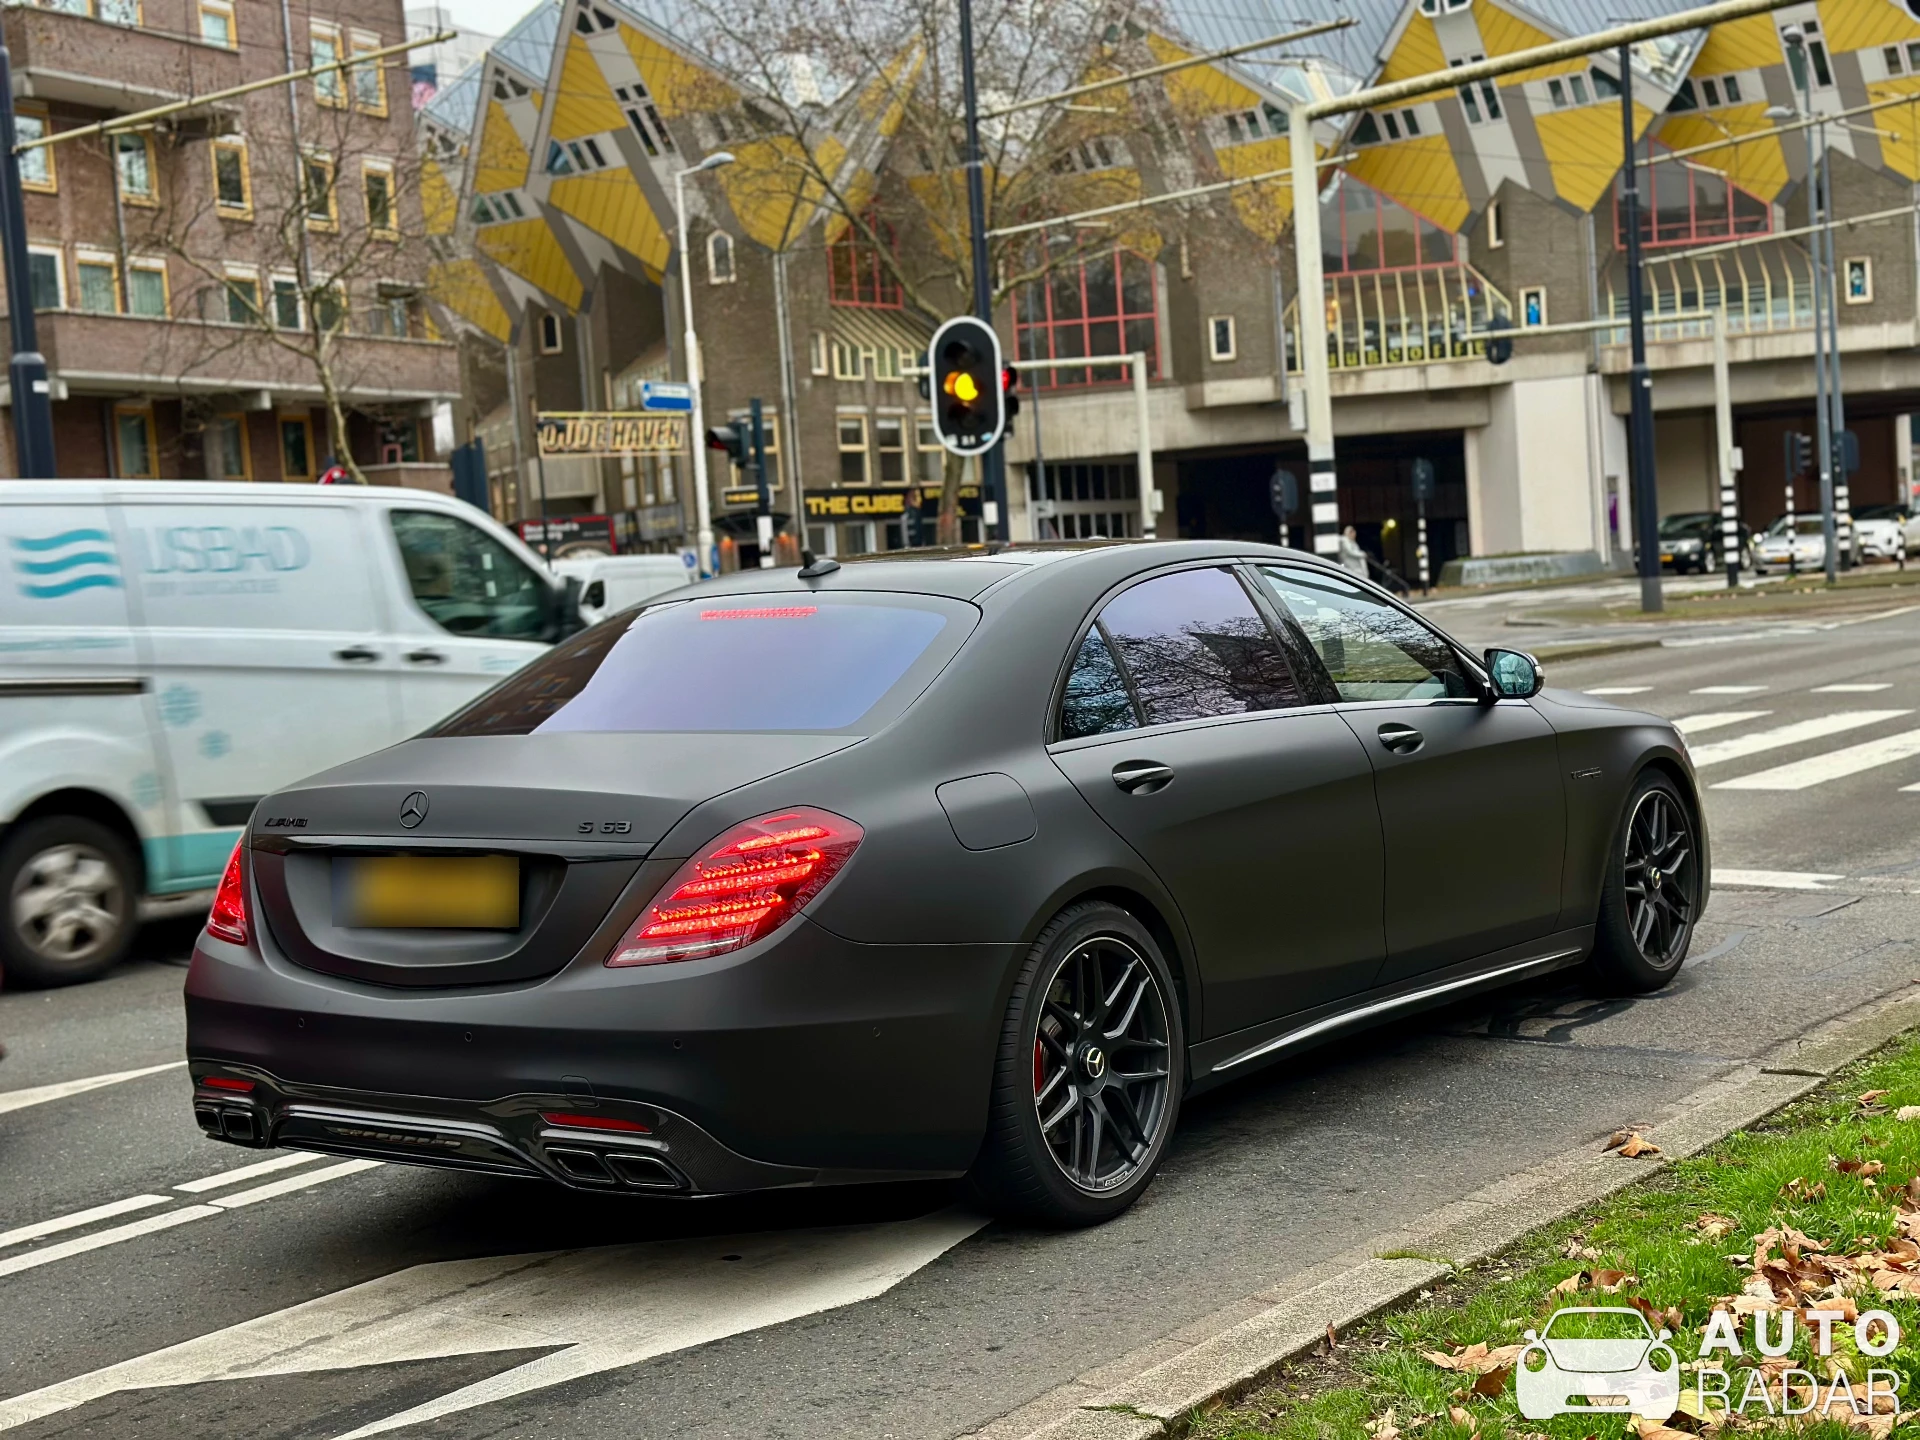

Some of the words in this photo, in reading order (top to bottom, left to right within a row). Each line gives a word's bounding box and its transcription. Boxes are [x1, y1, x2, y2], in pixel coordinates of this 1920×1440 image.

[611, 418, 684, 450] HAVEN
[806, 497, 849, 515] THE
[851, 494, 905, 513] CUBE
[274, 817, 308, 828] AMG
[578, 821, 593, 834] S
[600, 820, 632, 834] 63
